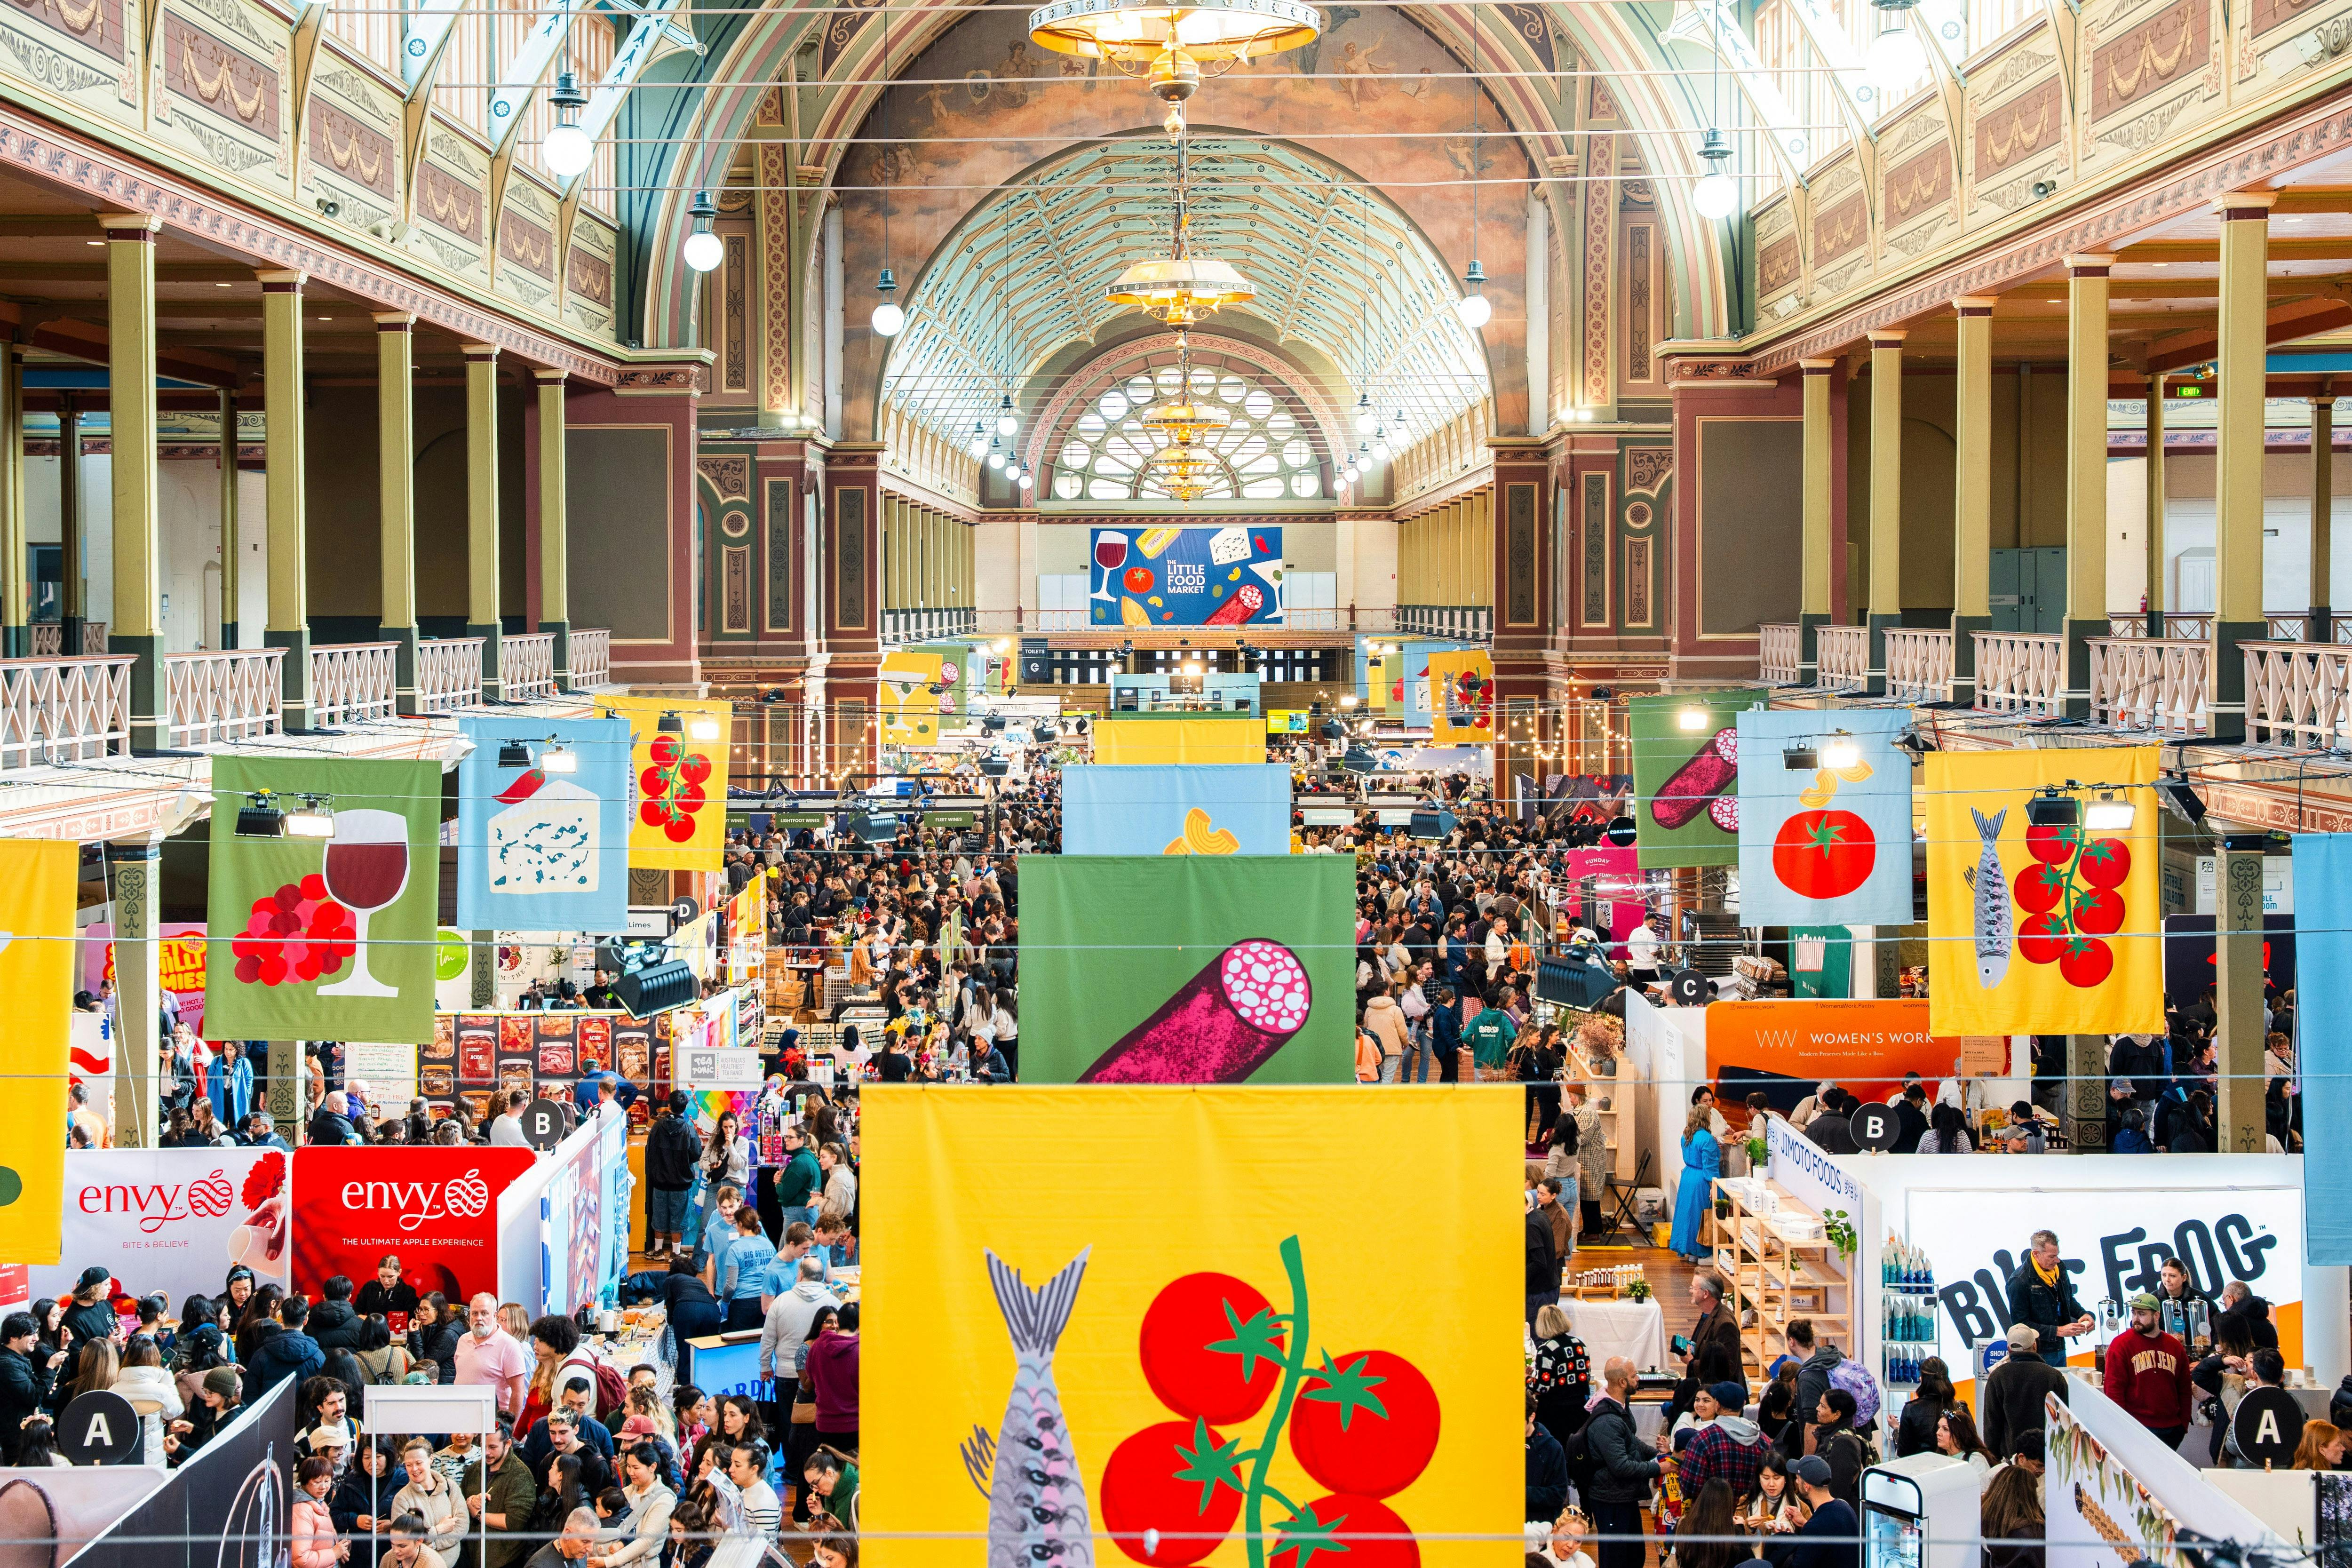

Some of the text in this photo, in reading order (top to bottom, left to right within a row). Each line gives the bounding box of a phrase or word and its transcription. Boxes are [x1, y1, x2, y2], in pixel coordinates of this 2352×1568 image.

[1167, 564, 1205, 575] LITTLE
[1168, 575, 1206, 586] FOOD
[679, 904, 690, 917] D
[1684, 980, 1697, 995] C
[1810, 1032, 1934, 1044] WOMEN'S WORK
[694, 1056, 713, 1066] TEA
[535, 1113, 550, 1134] B
[1867, 1115, 1884, 1138] B
[1781, 1132, 1841, 1194] JIMOTO FOODS
[79, 1184, 189, 1233] envy
[342, 1181, 445, 1231] envy
[153, 1240, 189, 1248] BELIEVE
[2131, 1350, 2157, 1376] TOMMY
[83, 1412, 113, 1446] A
[2255, 1409, 2281, 1444] A
